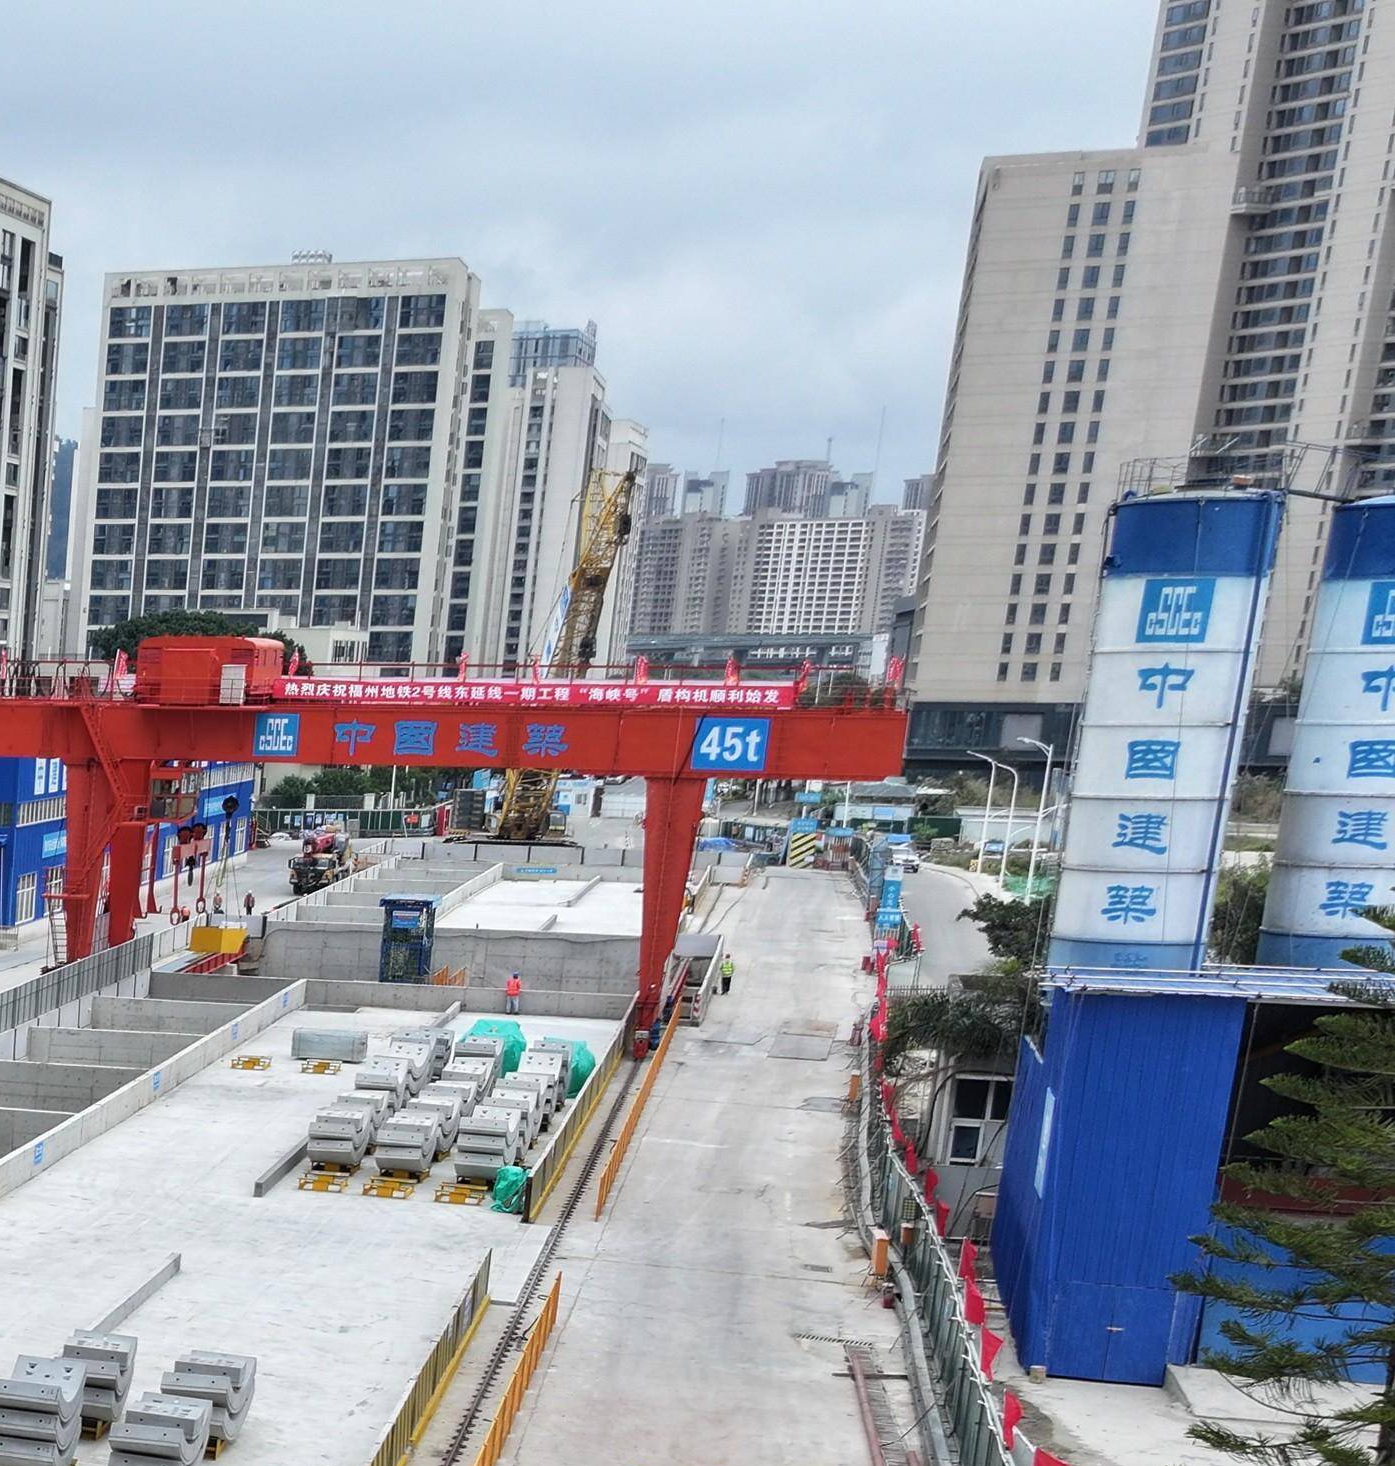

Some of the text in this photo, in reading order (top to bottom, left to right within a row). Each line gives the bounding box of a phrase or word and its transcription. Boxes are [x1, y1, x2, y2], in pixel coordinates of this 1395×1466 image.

[284, 682, 570, 701] 热烈庆祝福州地铁2号线东延线一期工程
[657, 687, 780, 703] 盾构机顺利始发
[700, 726, 761, 762] 45t
